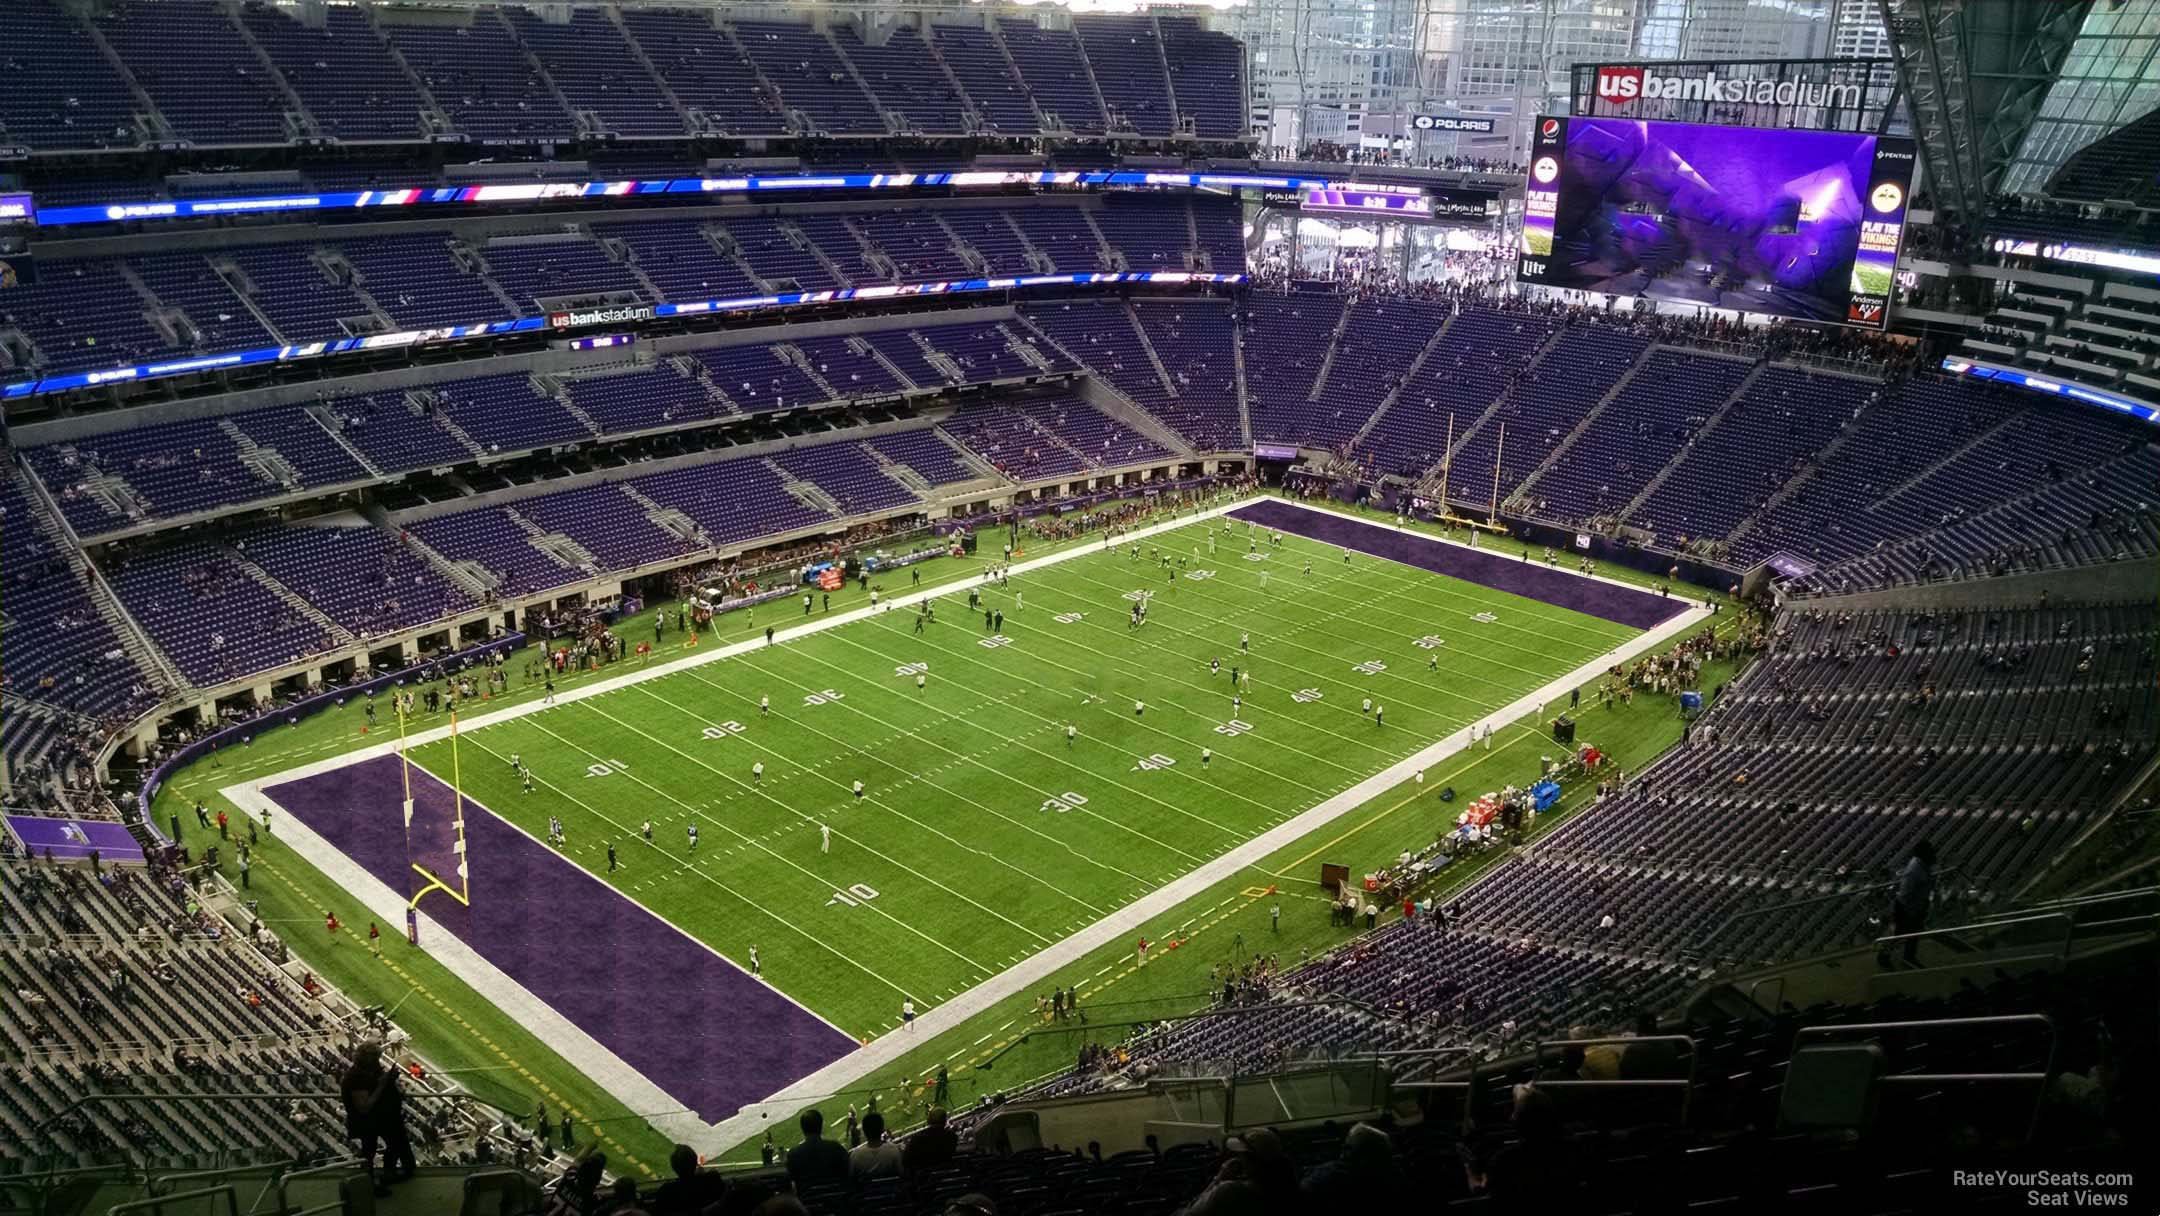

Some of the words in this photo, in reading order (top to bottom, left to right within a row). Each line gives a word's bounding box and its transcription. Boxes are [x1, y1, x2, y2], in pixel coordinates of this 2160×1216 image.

[1435, 119, 1490, 131] POLARIS
[1885, 152, 1913, 160] PENTAIR
[1861, 221, 1883, 234] PLAY
[1884, 223, 1901, 236] THE
[1860, 232, 1899, 247] VIKINGS
[1522, 259, 1546, 277] Lite
[1851, 295, 1883, 304] Andersen
[1351, 661, 1388, 676] 30
[804, 689, 846, 705] 30
[1291, 689, 1324, 703] 40
[702, 720, 747, 739] 20
[1213, 719, 1255, 737] 50
[587, 759, 630, 777] 10
[1138, 753, 1177, 771] 40
[1042, 791, 1089, 813] 30
[832, 884, 880, 907] 10
